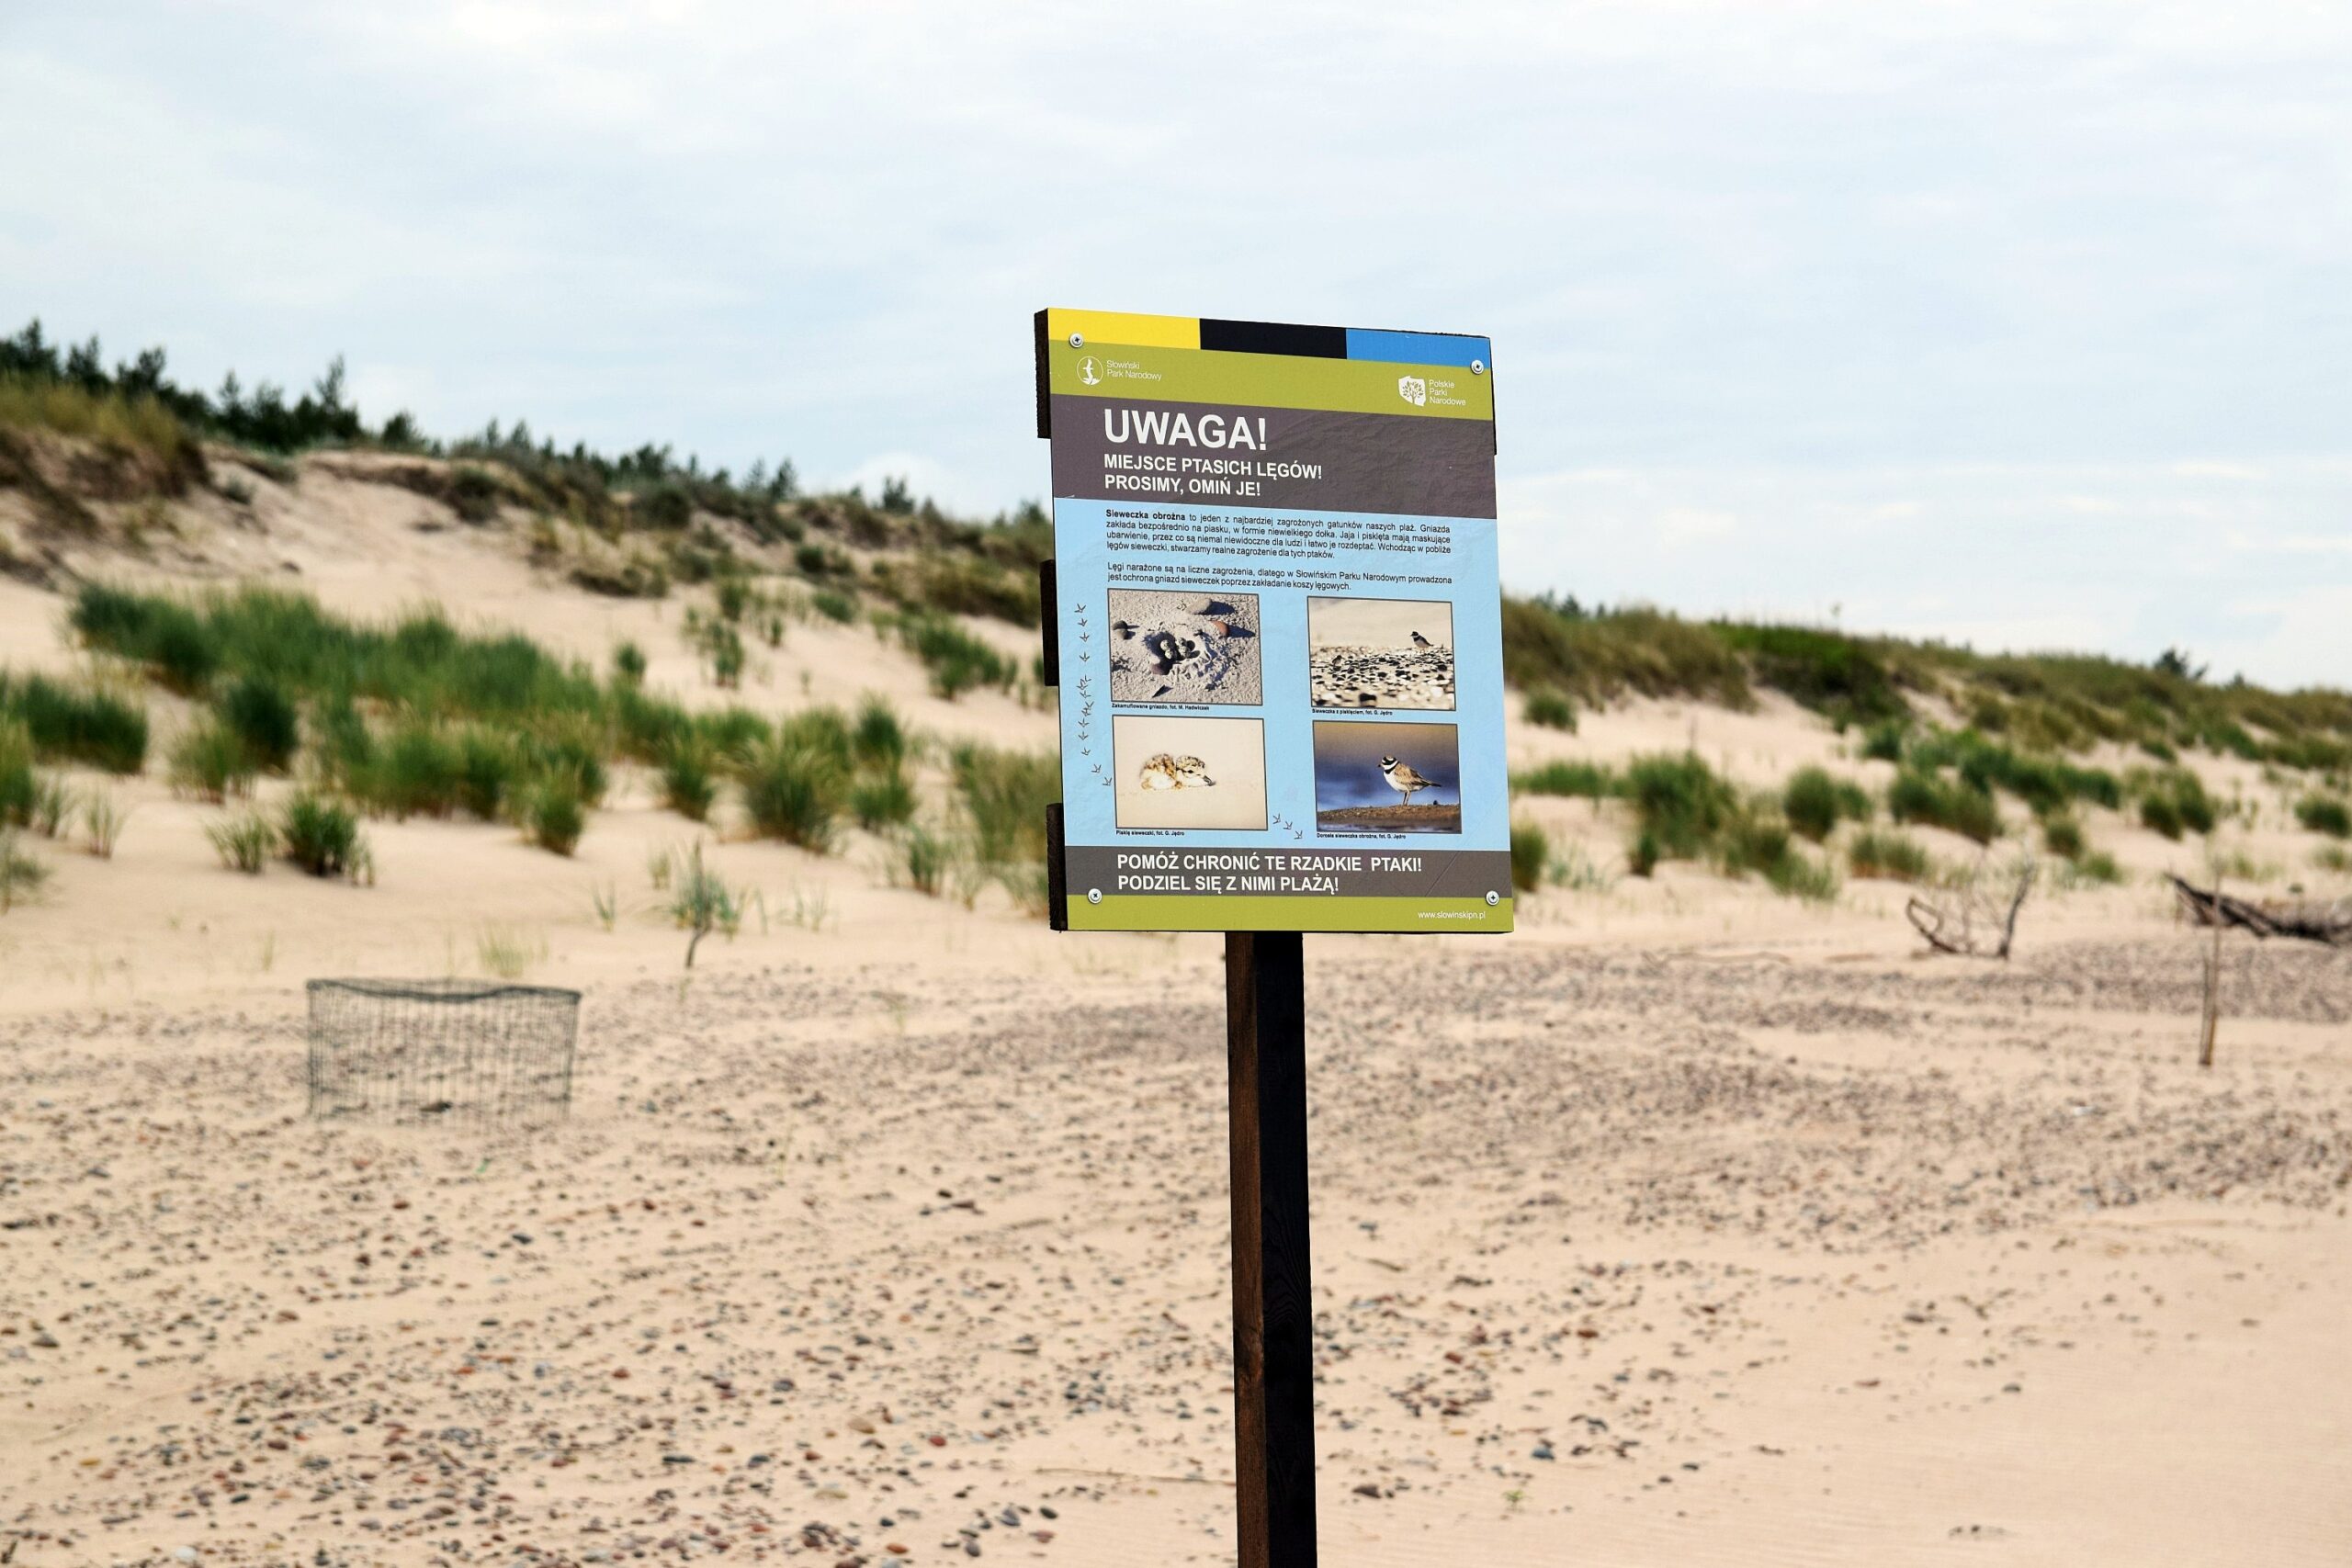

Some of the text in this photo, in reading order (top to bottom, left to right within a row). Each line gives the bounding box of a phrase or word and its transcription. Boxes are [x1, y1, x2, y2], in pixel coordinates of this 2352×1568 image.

[1107, 360, 1140, 369] Słowiński
[1107, 369, 1161, 381] Park Narodowy
[1430, 379, 1454, 388] Polskie
[1430, 397, 1465, 405] Narodowe
[1104, 409, 1267, 451] UWAGA!
[1104, 454, 1322, 482] MIEJSCE PTASICH LĘGÓW!
[1105, 475, 1261, 497] PROSIMY, OMIŃ JE!
[1106, 510, 1148, 518] Sieweczka
[1153, 512, 1185, 521] obrożna
[1200, 514, 1221, 523] jeden
[1233, 516, 1273, 526] najbardziej
[1277, 519, 1323, 527] zagrożonych
[1420, 525, 1450, 534] Gniazda
[1106, 521, 1136, 529] zakłada
[1139, 522, 1189, 531] bezpośrednio
[1204, 525, 1230, 534] piasku,
[1242, 525, 1265, 535] formie
[1268, 528, 1313, 537] niewielkiego
[1316, 530, 1337, 538] dołka.
[1340, 531, 1355, 539] Jaja
[1363, 533, 1389, 542] pisklęta
[1392, 535, 1409, 543] mają
[1412, 535, 1450, 544] maskujące
[1107, 532, 1149, 541] ubarwienie,
[1225, 536, 1270, 546] niewidoczne
[1285, 538, 1302, 547] ludzi
[1329, 541, 1336, 549] je
[1339, 542, 1375, 550] rozdeptać.
[1378, 544, 1415, 553] Wchodząc
[1426, 546, 1451, 554] pobliże
[1107, 542, 1129, 550] lęgów
[1131, 543, 1169, 552] sieweczki,
[1171, 545, 1211, 554] stwarzamy
[1237, 547, 1277, 556] zagrożenie
[1291, 549, 1306, 558] tych
[1307, 550, 1335, 558] ptaków.
[1108, 573, 1122, 582] jest
[1123, 574, 1154, 582] ochrona
[1182, 576, 1219, 584] sieweczek
[1252, 580, 1291, 588] zakładanie
[1293, 581, 1314, 590] koszy
[1316, 581, 1351, 591] lęgowych.
[1126, 563, 1162, 572] narażone
[1165, 566, 1173, 574] są
[1212, 567, 1255, 577] zagrożenia,
[1258, 569, 1284, 578] dlatego
[1296, 570, 1337, 579] Słowińskim
[1363, 573, 1406, 583] Narodowym
[1408, 576, 1452, 584] prowadzona
[1117, 852, 1421, 872] POMÓŻ CHRONIĆ TE RZADKIE PTAKI!
[1118, 874, 1339, 894] PODZIEL SIĘ Z NIMI PLAŻĄ!
[1419, 911, 1486, 919] www.slowinskipn.pl
